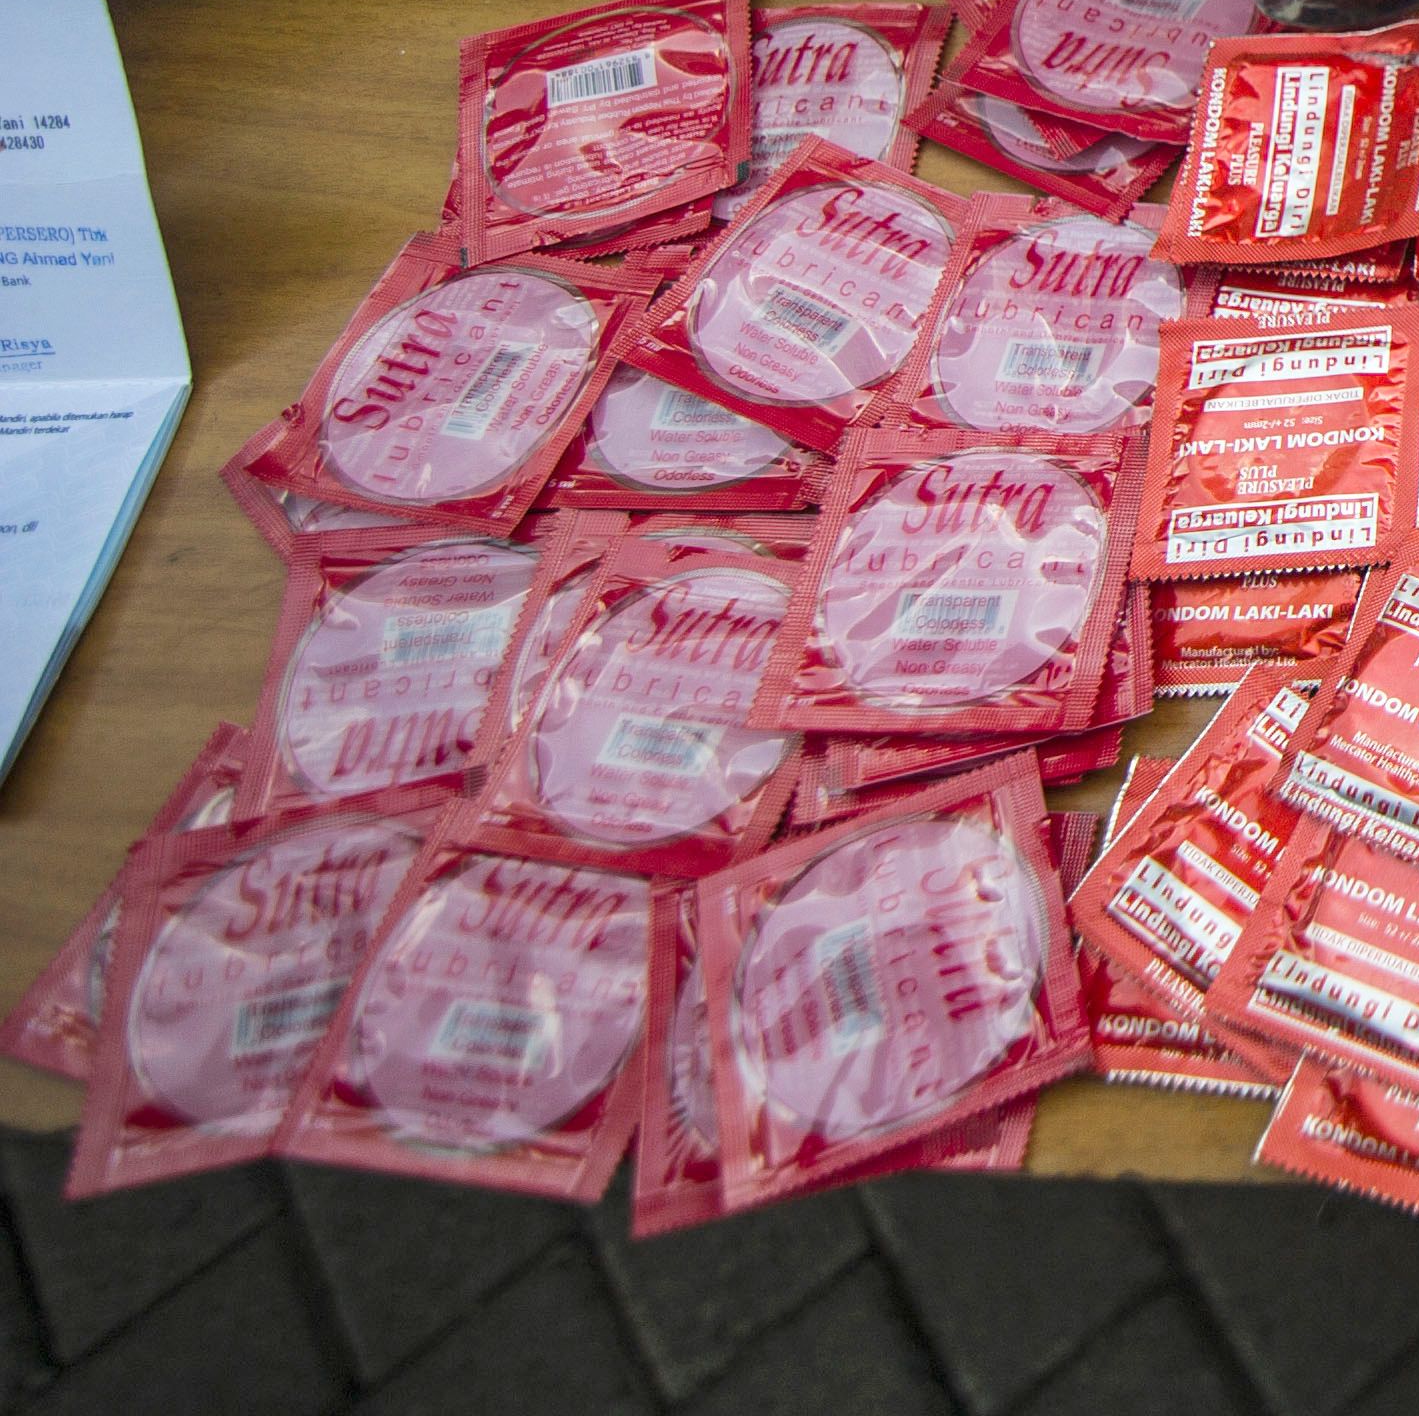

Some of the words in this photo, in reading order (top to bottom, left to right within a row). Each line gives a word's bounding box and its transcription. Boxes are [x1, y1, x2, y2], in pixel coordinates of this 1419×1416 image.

[34, 115, 70, 129] 14284
[801, 188, 933, 280] Sutra
[23, 252, 77, 265] Ahmad
[81, 252, 114, 265] Yani
[1009, 230, 1144, 298] Sutra
[2, 276, 30, 286] Bank
[770, 288, 844, 332] Transparent
[1, 339, 52, 352] Risya
[739, 321, 777, 346] Water
[779, 334, 820, 366] Soluble
[333, 308, 458, 430] Sutra
[734, 341, 760, 363] Non
[762, 351, 802, 384] Greasy
[729, 365, 780, 395] Odorless
[1179, 435, 1280, 456] LAKI-LAKI
[1285, 426, 1384, 449] KONDOM
[1238, 476, 1312, 494] PLEASURE
[902, 465, 1055, 534] Sutra
[1274, 496, 1374, 521] Lindungi
[1174, 508, 1269, 531] Keluarga
[1172, 536, 1228, 560] Diri
[1242, 526, 1370, 554] Lindungi
[910, 593, 1001, 609] Transparent
[915, 615, 985, 630] Colorless
[892, 637, 939, 652] Water
[944, 637, 998, 652] Soluble
[896, 660, 930, 675] Non
[934, 660, 985, 679] Greasy
[901, 681, 970, 696] Odorless
